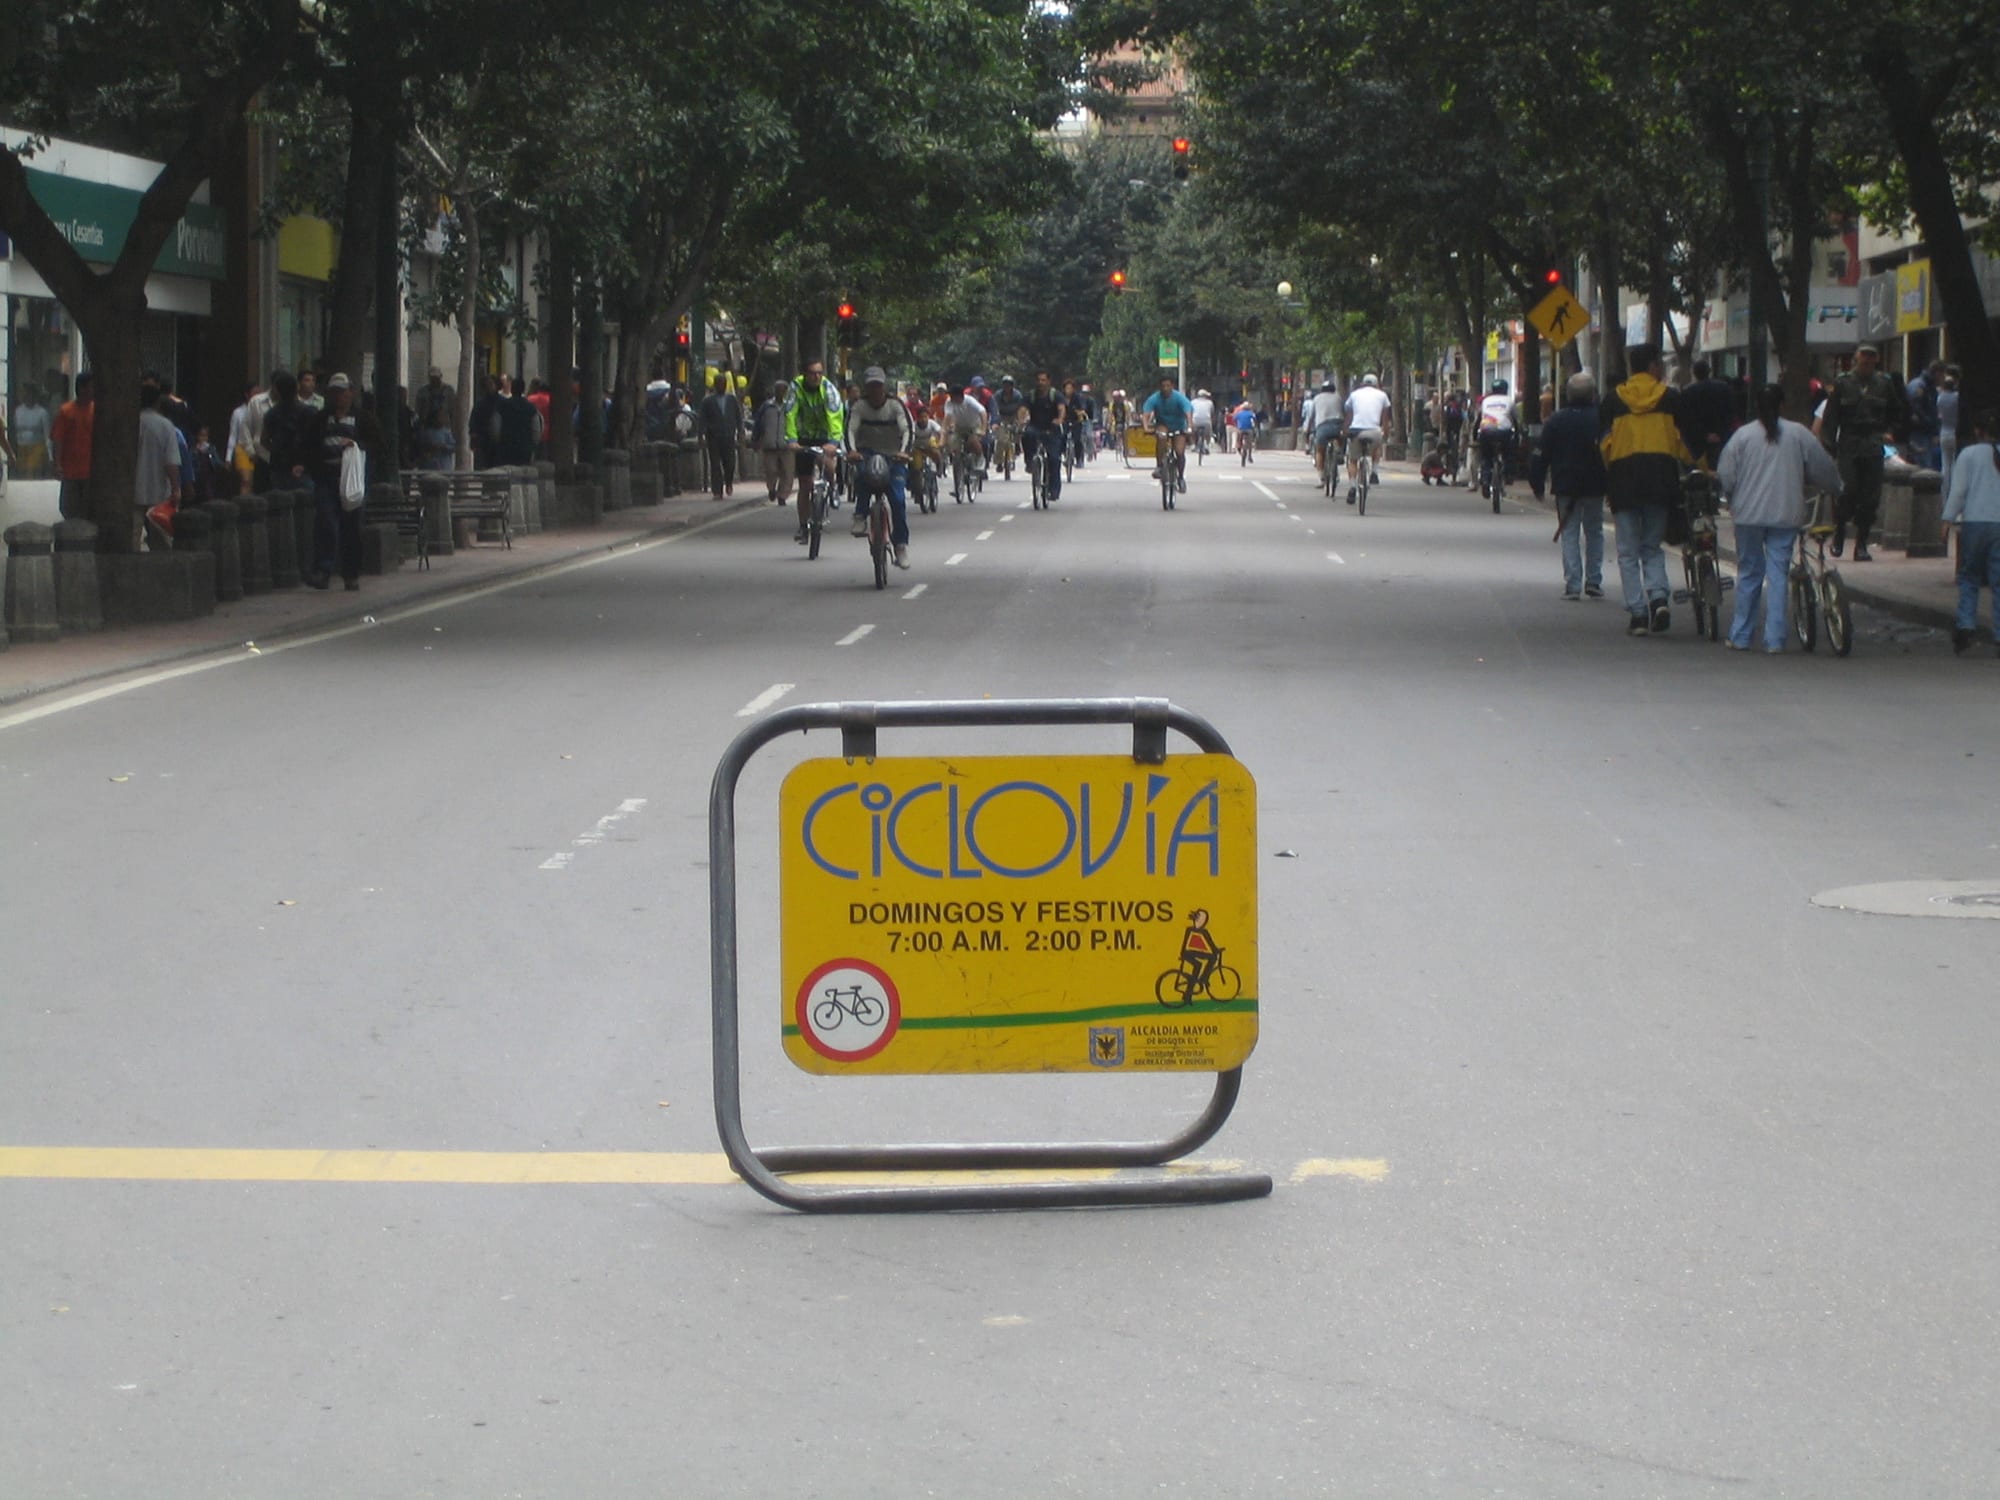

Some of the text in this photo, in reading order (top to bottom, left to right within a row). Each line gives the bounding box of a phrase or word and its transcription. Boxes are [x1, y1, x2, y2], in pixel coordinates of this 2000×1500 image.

[849, 900, 1173, 924] DOMINGOS Y FESTIVOS
[887, 929, 1142, 952] 7:00 A.M. 2:00 P.M.
[1182, 1025, 1218, 1035] MAYOR
